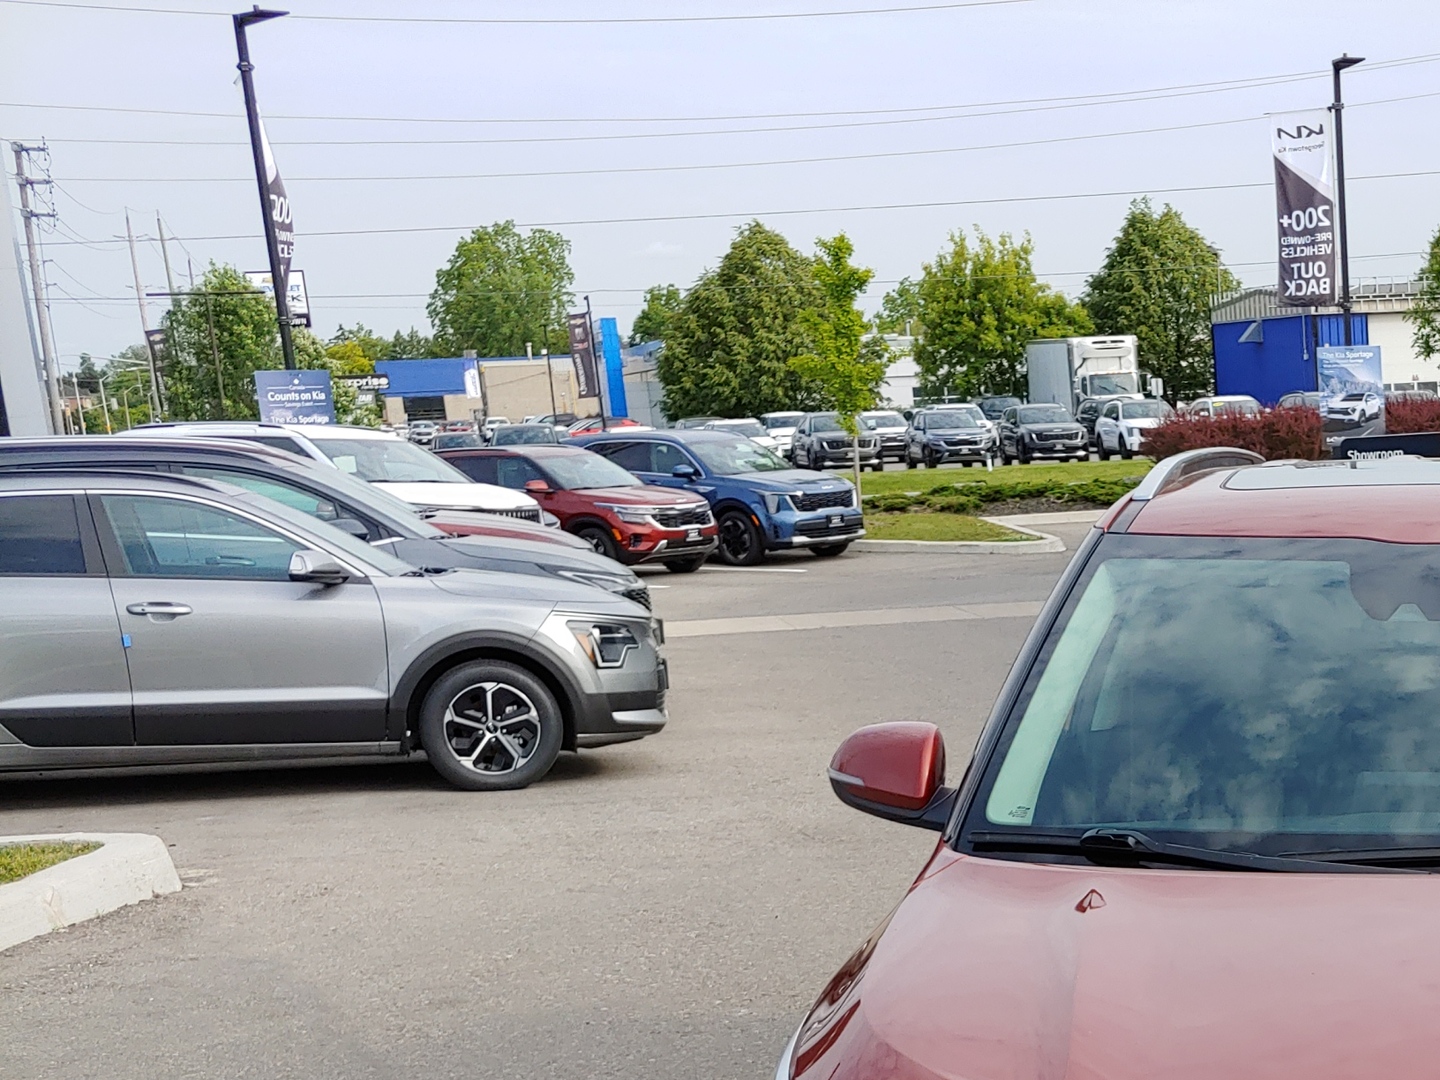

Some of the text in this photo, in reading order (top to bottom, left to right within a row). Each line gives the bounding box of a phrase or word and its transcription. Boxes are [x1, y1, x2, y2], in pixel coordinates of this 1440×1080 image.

[267, 390, 326, 402] Counts on Kia
[298, 415, 330, 425] Sportage
